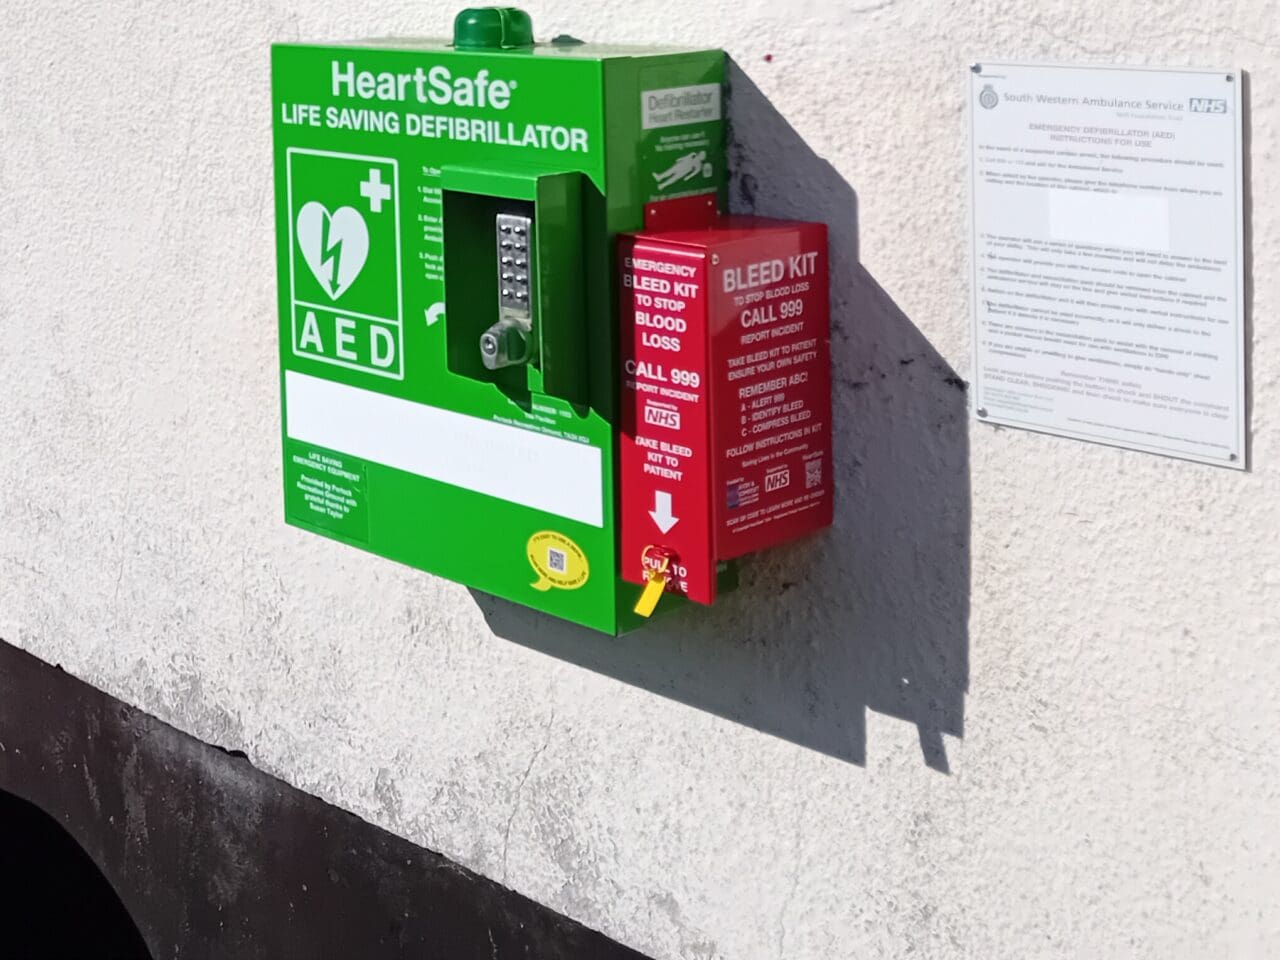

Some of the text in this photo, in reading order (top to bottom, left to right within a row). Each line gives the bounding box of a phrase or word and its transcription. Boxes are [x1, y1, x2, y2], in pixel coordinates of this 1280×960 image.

[1004, 92, 1185, 112] South Western Ambulance Service
[1191, 99, 1226, 113] NHS
[281, 103, 589, 153] LIFE SAVING DEFIBRILLATOR
[625, 257, 696, 278] EMERGENCY
[723, 252, 818, 293] BLEED KIT
[624, 274, 699, 298] BLEED KIT
[734, 282, 810, 306] TO STOP BLOOD LOSS
[635, 294, 686, 313] TO STOP
[741, 299, 803, 328] CALL 999
[635, 311, 687, 333] BLOOD
[740, 322, 804, 345] REPORT INCIDENT
[299, 311, 395, 368] AED
[642, 332, 681, 353] LOSS
[727, 338, 817, 368] TAKE BLEED KIT TO PATIENT
[625, 360, 700, 388] CALL 999
[728, 351, 817, 381] ENSURE YOUR OWN SAFETY
[738, 371, 808, 399] REMEMBER ABC!
[740, 403, 746, 412] A
[751, 395, 773, 409] ALERT
[741, 415, 746, 425] B
[782, 400, 804, 414] BLEED
[647, 409, 678, 427] NHS
[741, 428, 747, 437] C
[752, 416, 790, 433] COMPRESS
[790, 410, 811, 423] BLEED
[636, 435, 692, 458] TAKE BLEED
[726, 443, 755, 458] FOLLOW
[755, 430, 803, 450] INSTRUCTIONS
[647, 451, 679, 468] KIT TO
[643, 463, 683, 481] PATIENT
[766, 471, 788, 490] NHS
[672, 563, 687, 578] TO
